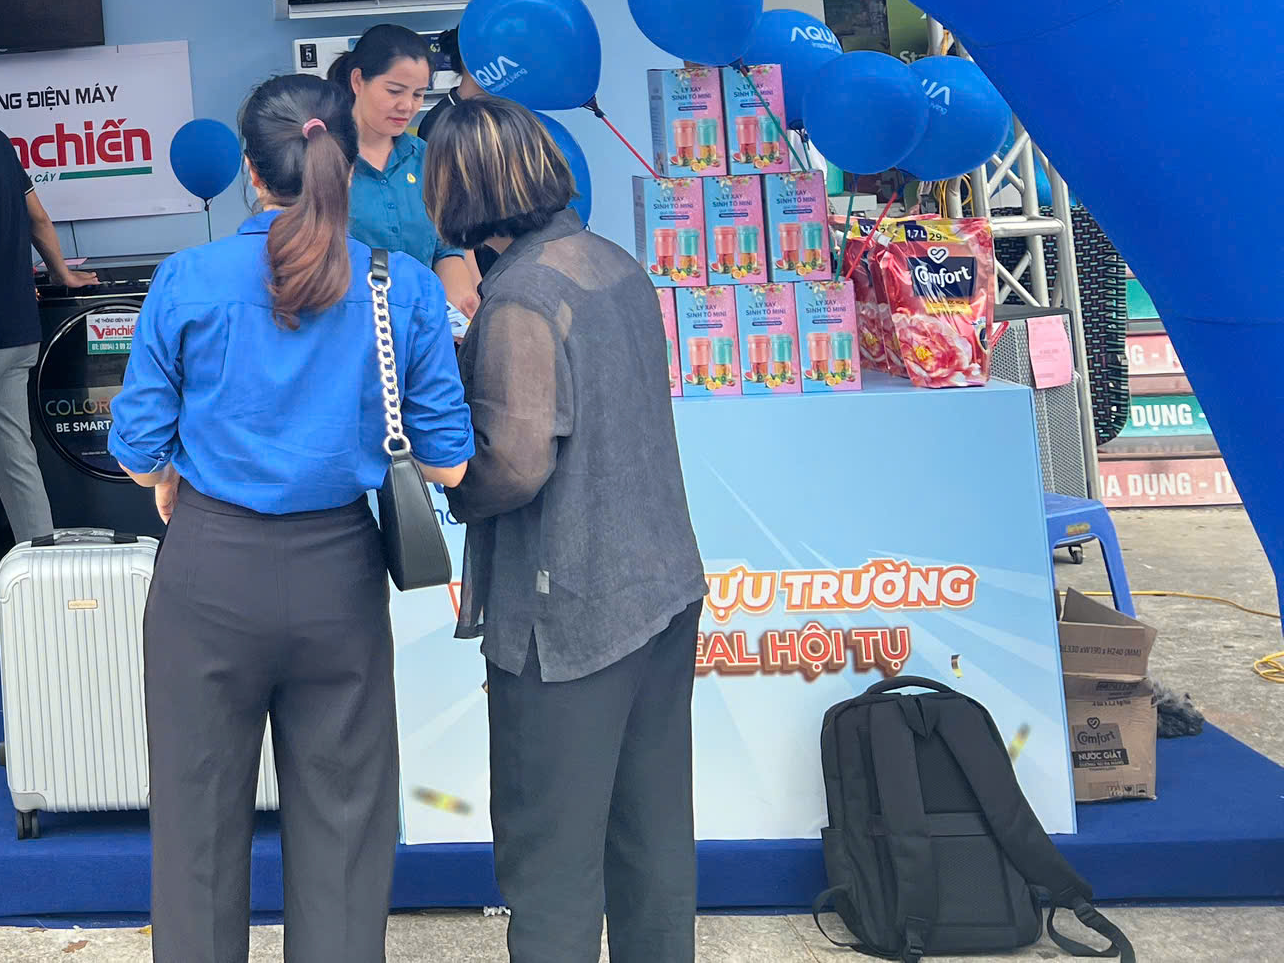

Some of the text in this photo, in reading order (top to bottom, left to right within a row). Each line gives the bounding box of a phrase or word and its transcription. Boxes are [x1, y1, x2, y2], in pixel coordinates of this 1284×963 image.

[305, 50, 313, 61] 5
[475, 55, 519, 88] QUA
[27, 86, 70, 110] ĐIỆN
[75, 83, 118, 105] MÁY
[915, 266, 972, 288] Comfort
[89, 325, 135, 339] Vănchi
[56, 420, 111, 433] BE SMART
[1131, 404, 1193, 430] DỤNG
[1128, 472, 1192, 502] DỤNG
[704, 559, 976, 623] ỰU TRƯỜNG
[768, 622, 845, 672] HỘI
[852, 627, 910, 671] TỤ
[1077, 730, 1116, 746] Comfort
